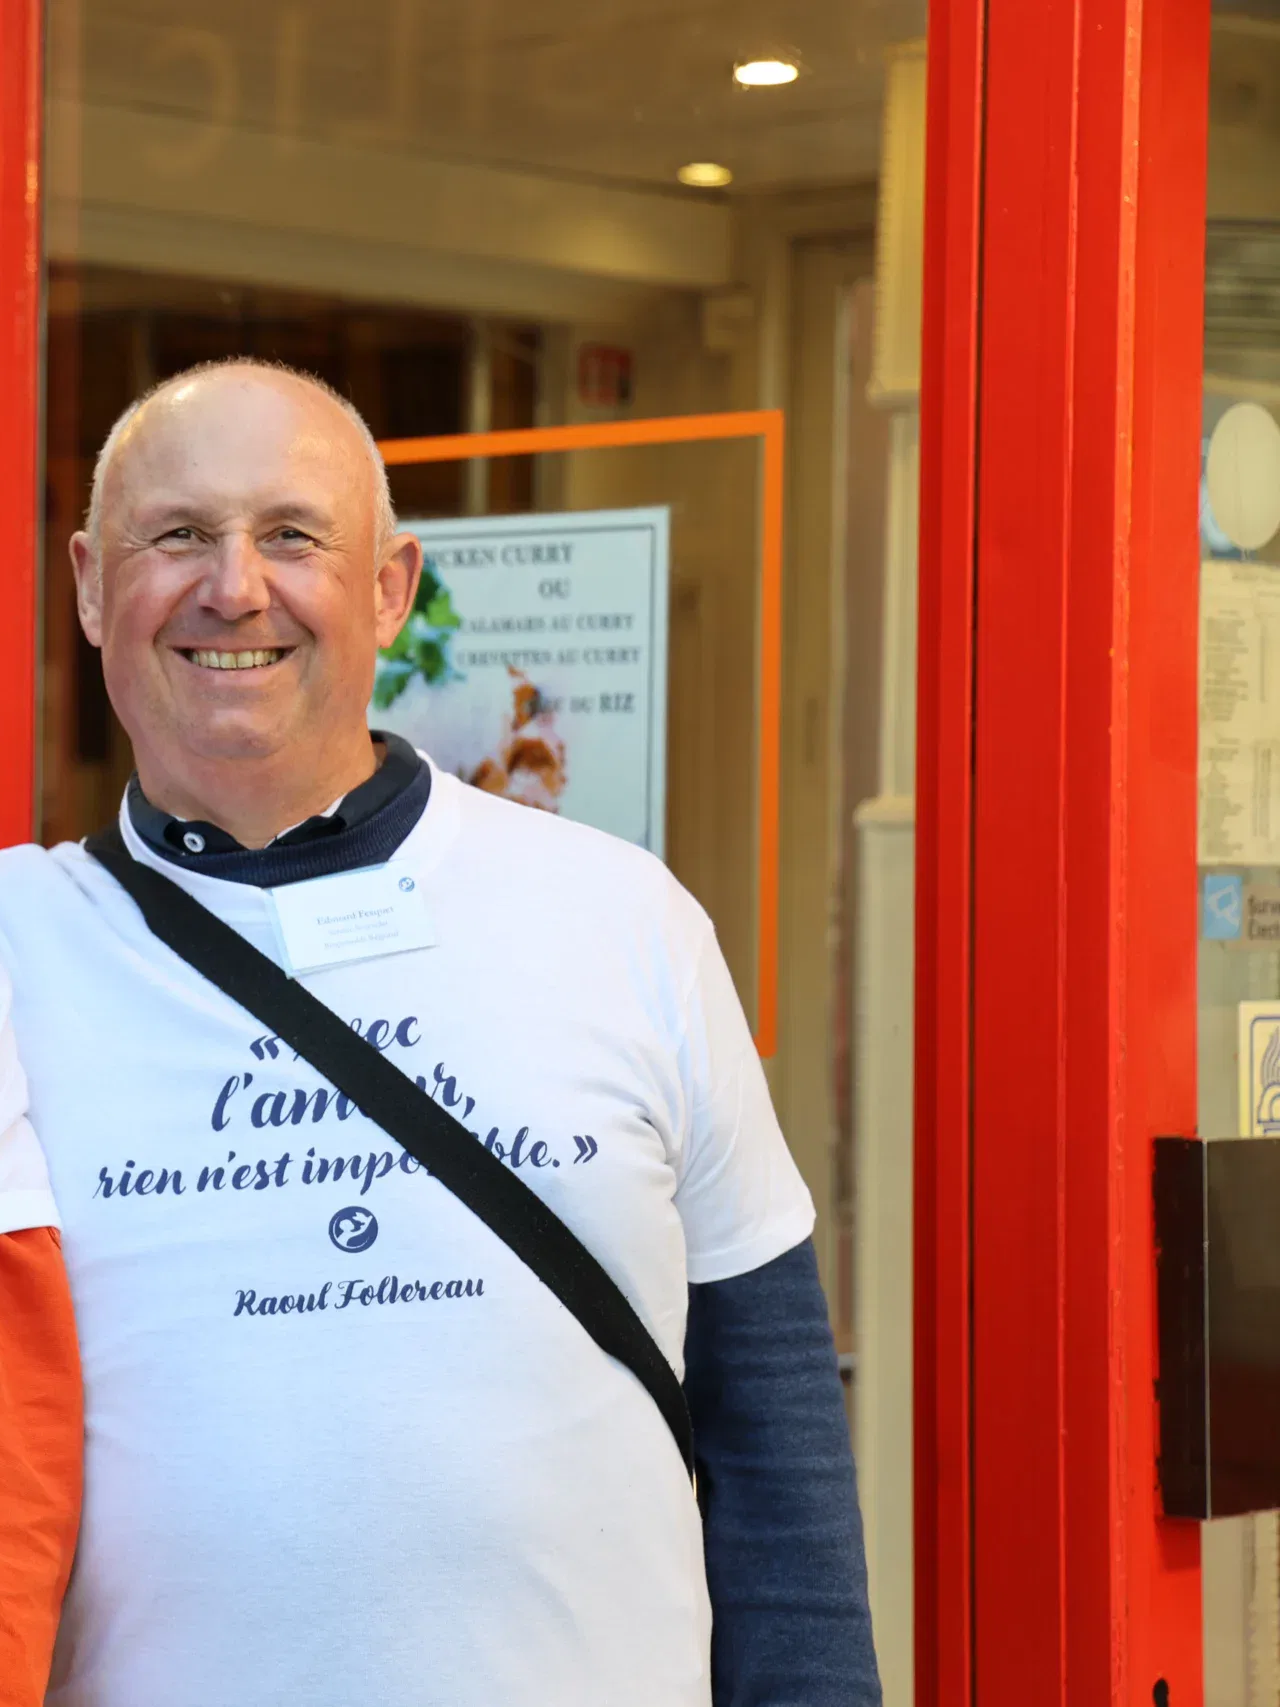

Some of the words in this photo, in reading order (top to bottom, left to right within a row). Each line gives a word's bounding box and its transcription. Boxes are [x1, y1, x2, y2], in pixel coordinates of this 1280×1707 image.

[499, 542, 573, 566] CURRY
[537, 577, 571, 600] OU
[576, 612, 635, 632] CURRY
[583, 646, 640, 665] CURRY
[94, 1159, 187, 1199] rien
[196, 1150, 294, 1193] n'est
[233, 1281, 332, 1317] Raoul
[333, 1274, 485, 1310] Follereau
